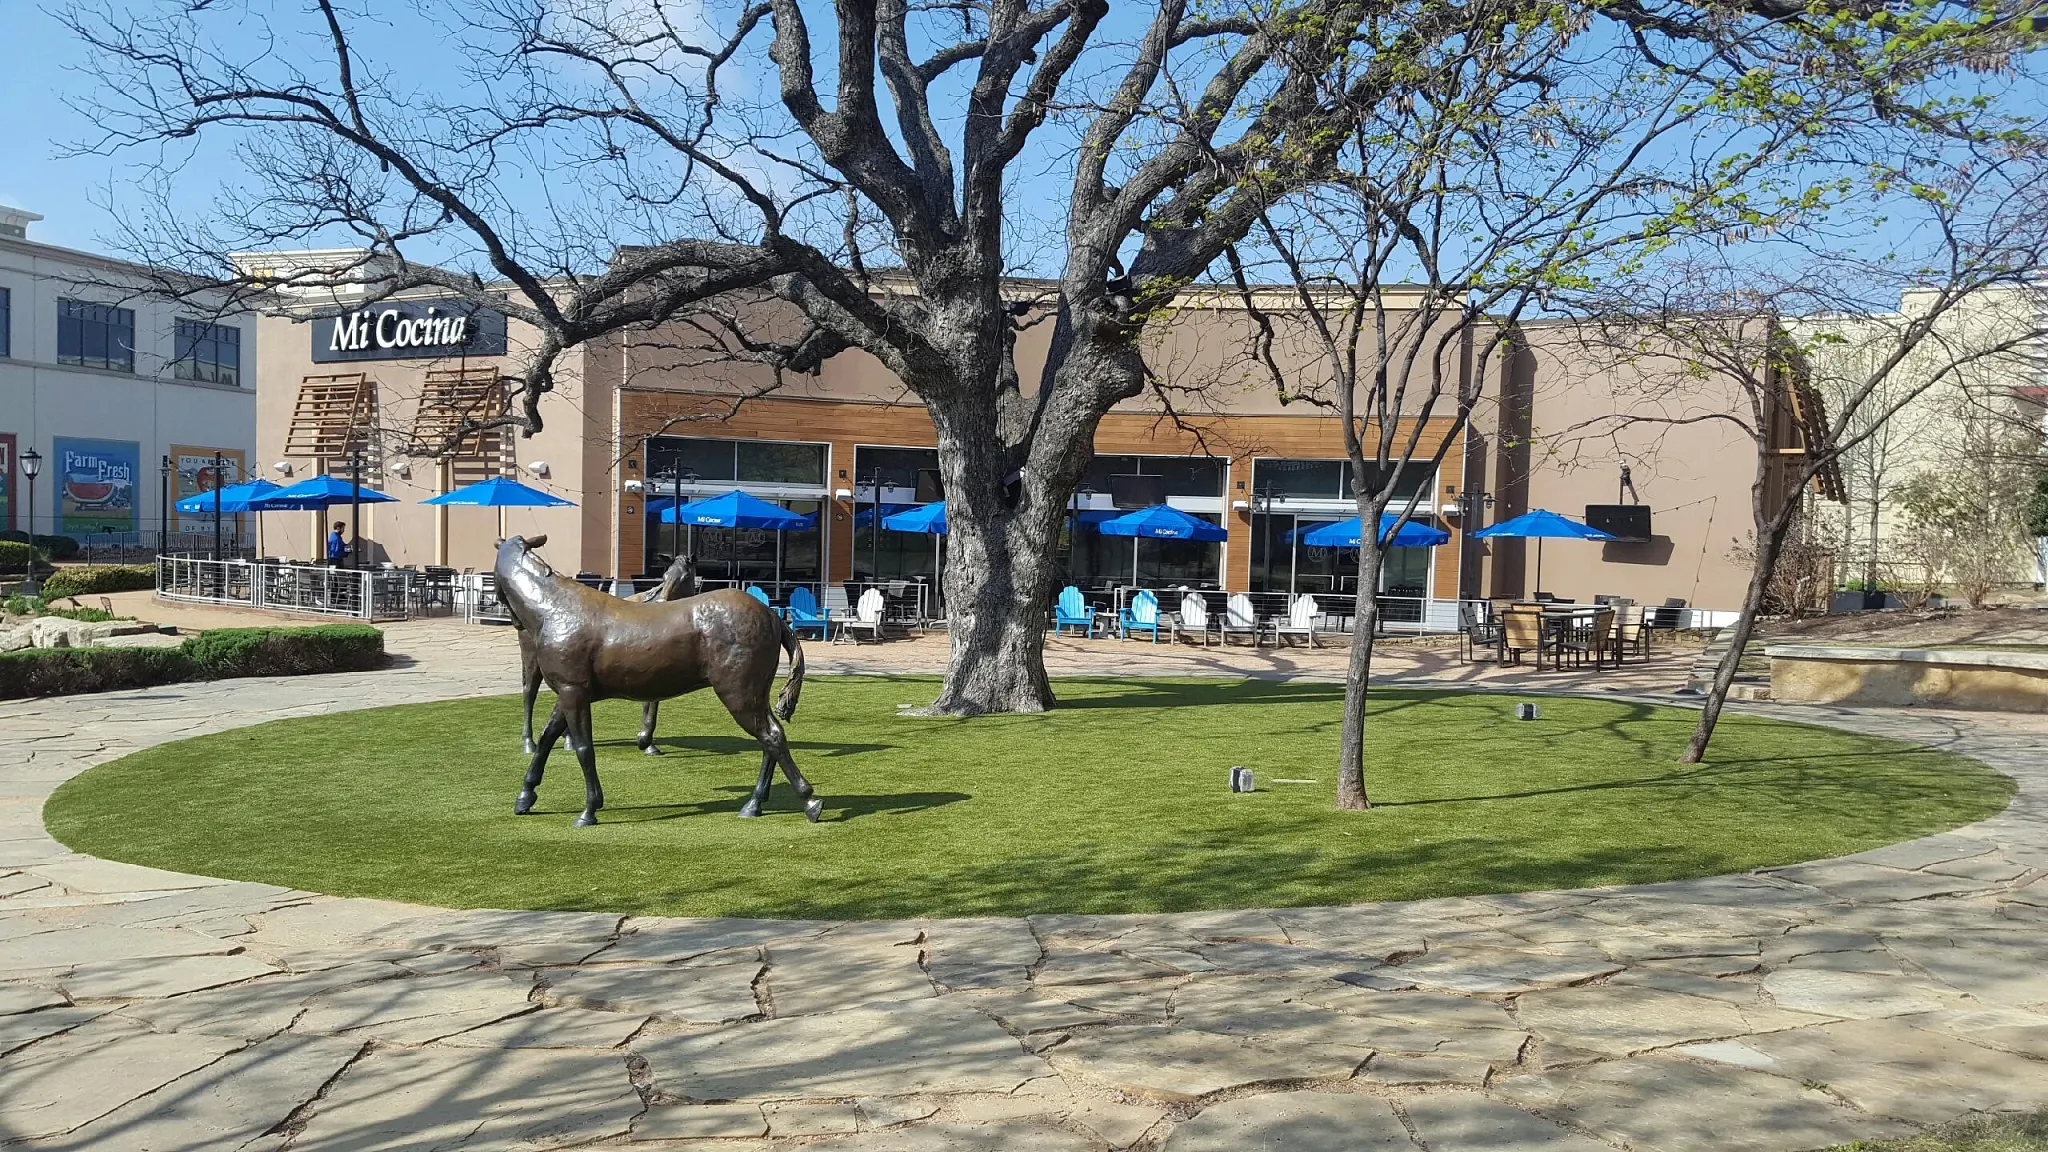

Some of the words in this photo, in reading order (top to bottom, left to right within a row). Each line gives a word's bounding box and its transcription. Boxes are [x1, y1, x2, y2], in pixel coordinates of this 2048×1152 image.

[330, 311, 369, 350] Mi
[376, 307, 466, 348] Cocina
[65, 451, 98, 473] Farm
[98, 460, 130, 482] Fresh
